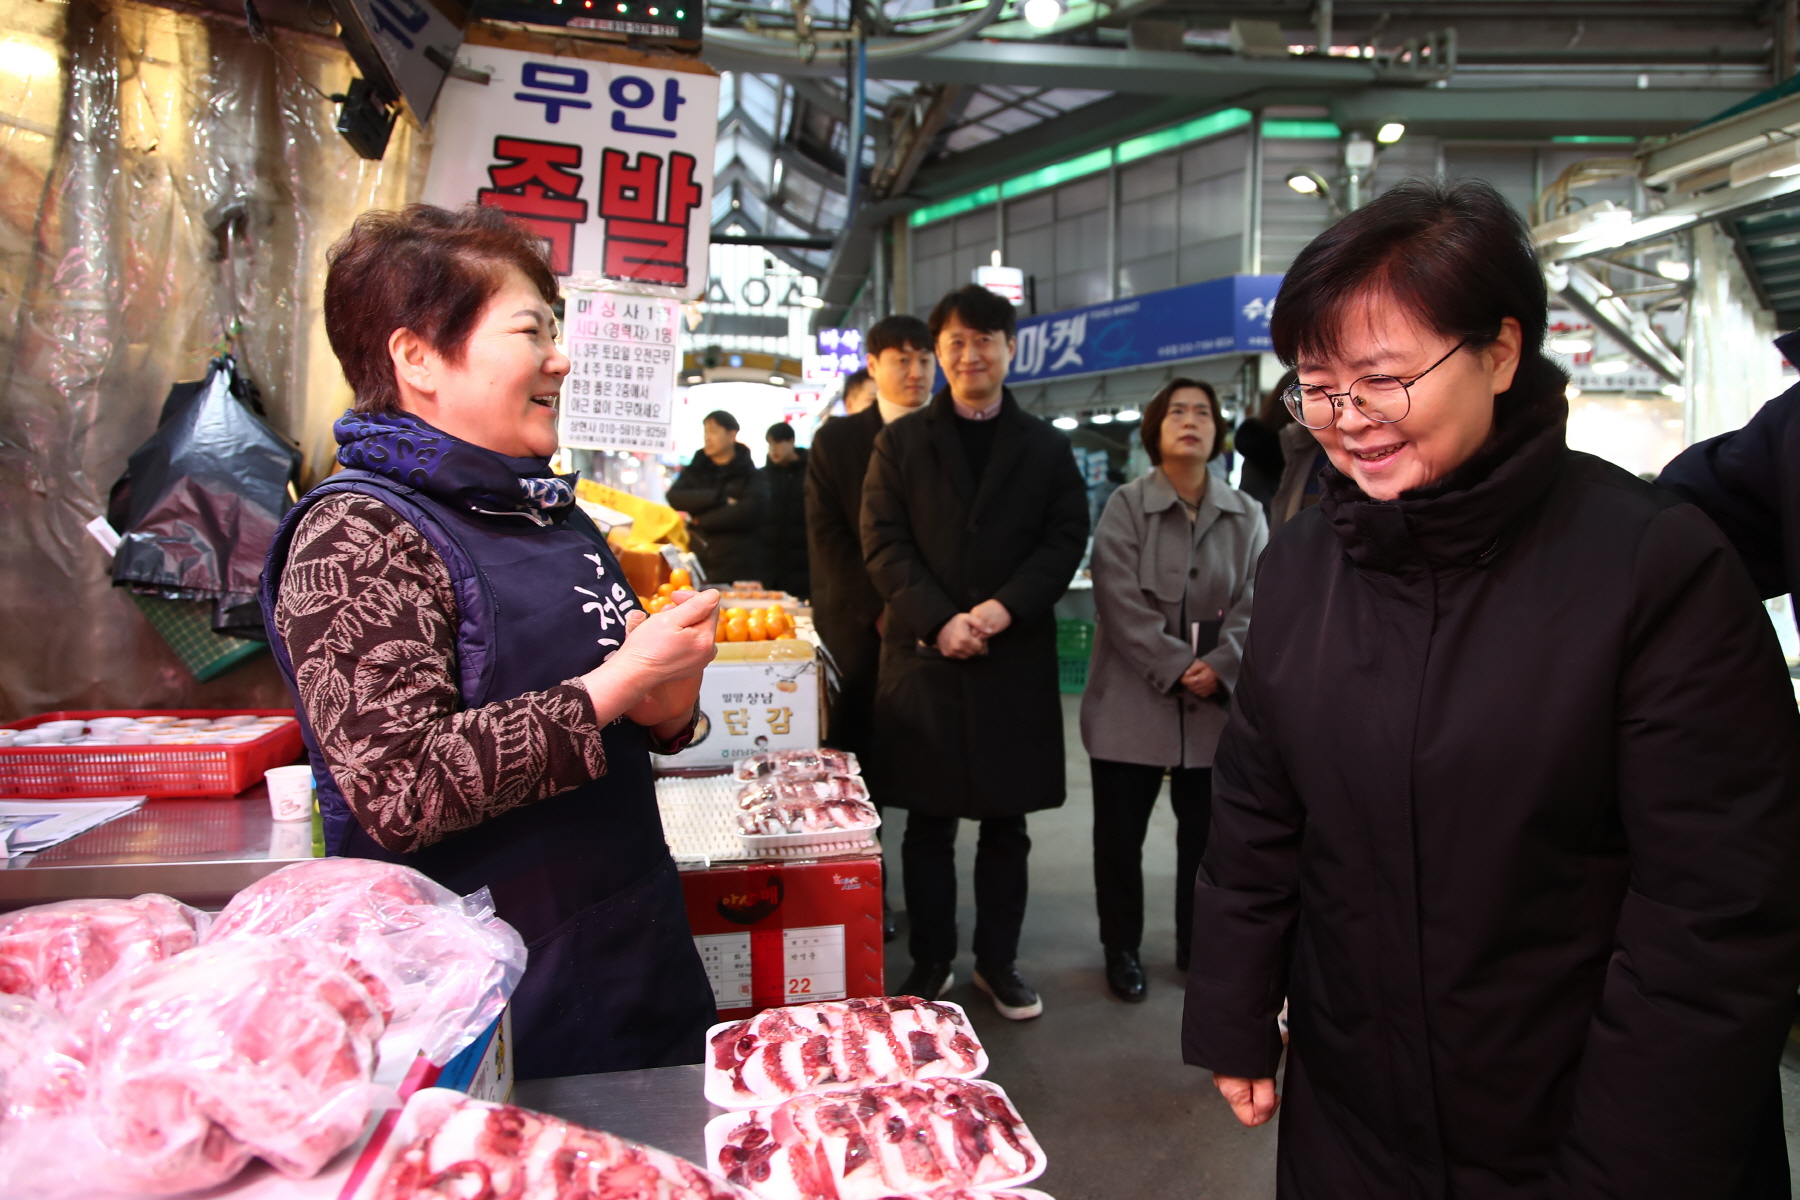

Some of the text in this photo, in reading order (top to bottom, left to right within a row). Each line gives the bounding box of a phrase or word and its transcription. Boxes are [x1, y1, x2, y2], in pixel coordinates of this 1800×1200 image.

[514, 62, 685, 138] 무안
[478, 135, 702, 288] 족발
[602, 345, 630, 361] 토요일
[1014, 312, 1088, 375] 마켓
[605, 363, 632, 379] 토요일
[637, 366, 654, 380] 휴무
[572, 379, 590, 395] 환경
[594, 380, 612, 396] 좋은
[571, 397, 660, 418] 야근 없이 근무하세요
[789, 978, 811, 994] 22
